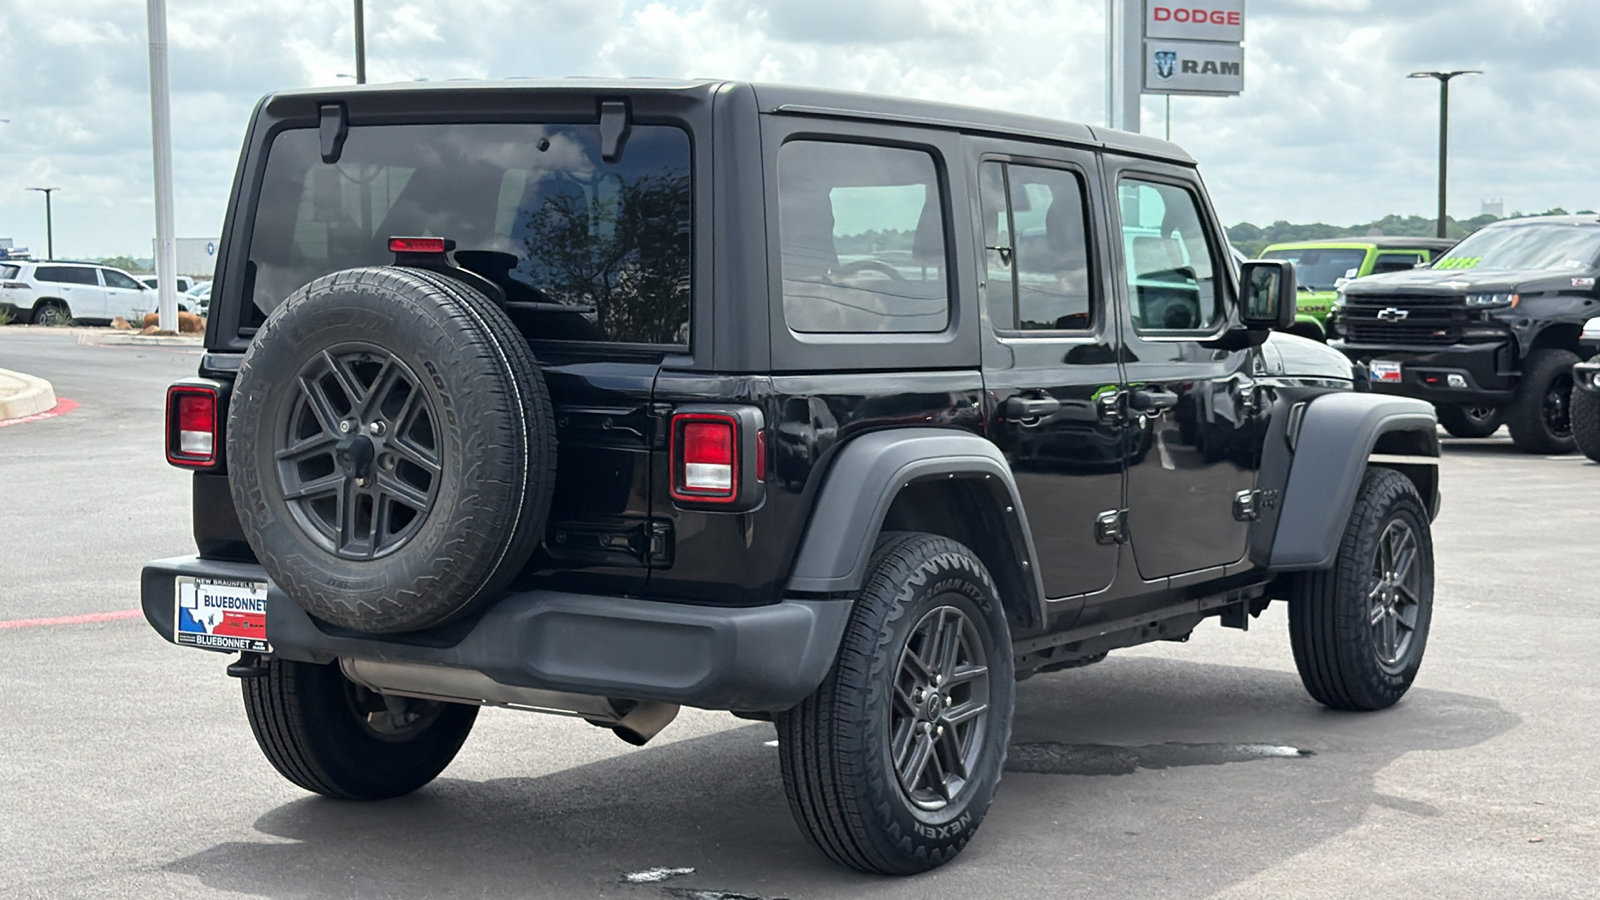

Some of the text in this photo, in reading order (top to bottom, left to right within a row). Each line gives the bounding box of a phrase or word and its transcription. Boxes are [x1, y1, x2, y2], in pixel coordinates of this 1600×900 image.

[1153, 7, 1241, 26] DODGE
[1181, 59, 1240, 76] RAM
[196, 577, 253, 588] NEW BRAUNFELS
[204, 595, 268, 612] BLUEBONNET
[196, 635, 251, 649] BLUEBONNET
[913, 810, 972, 839] NEXEN
